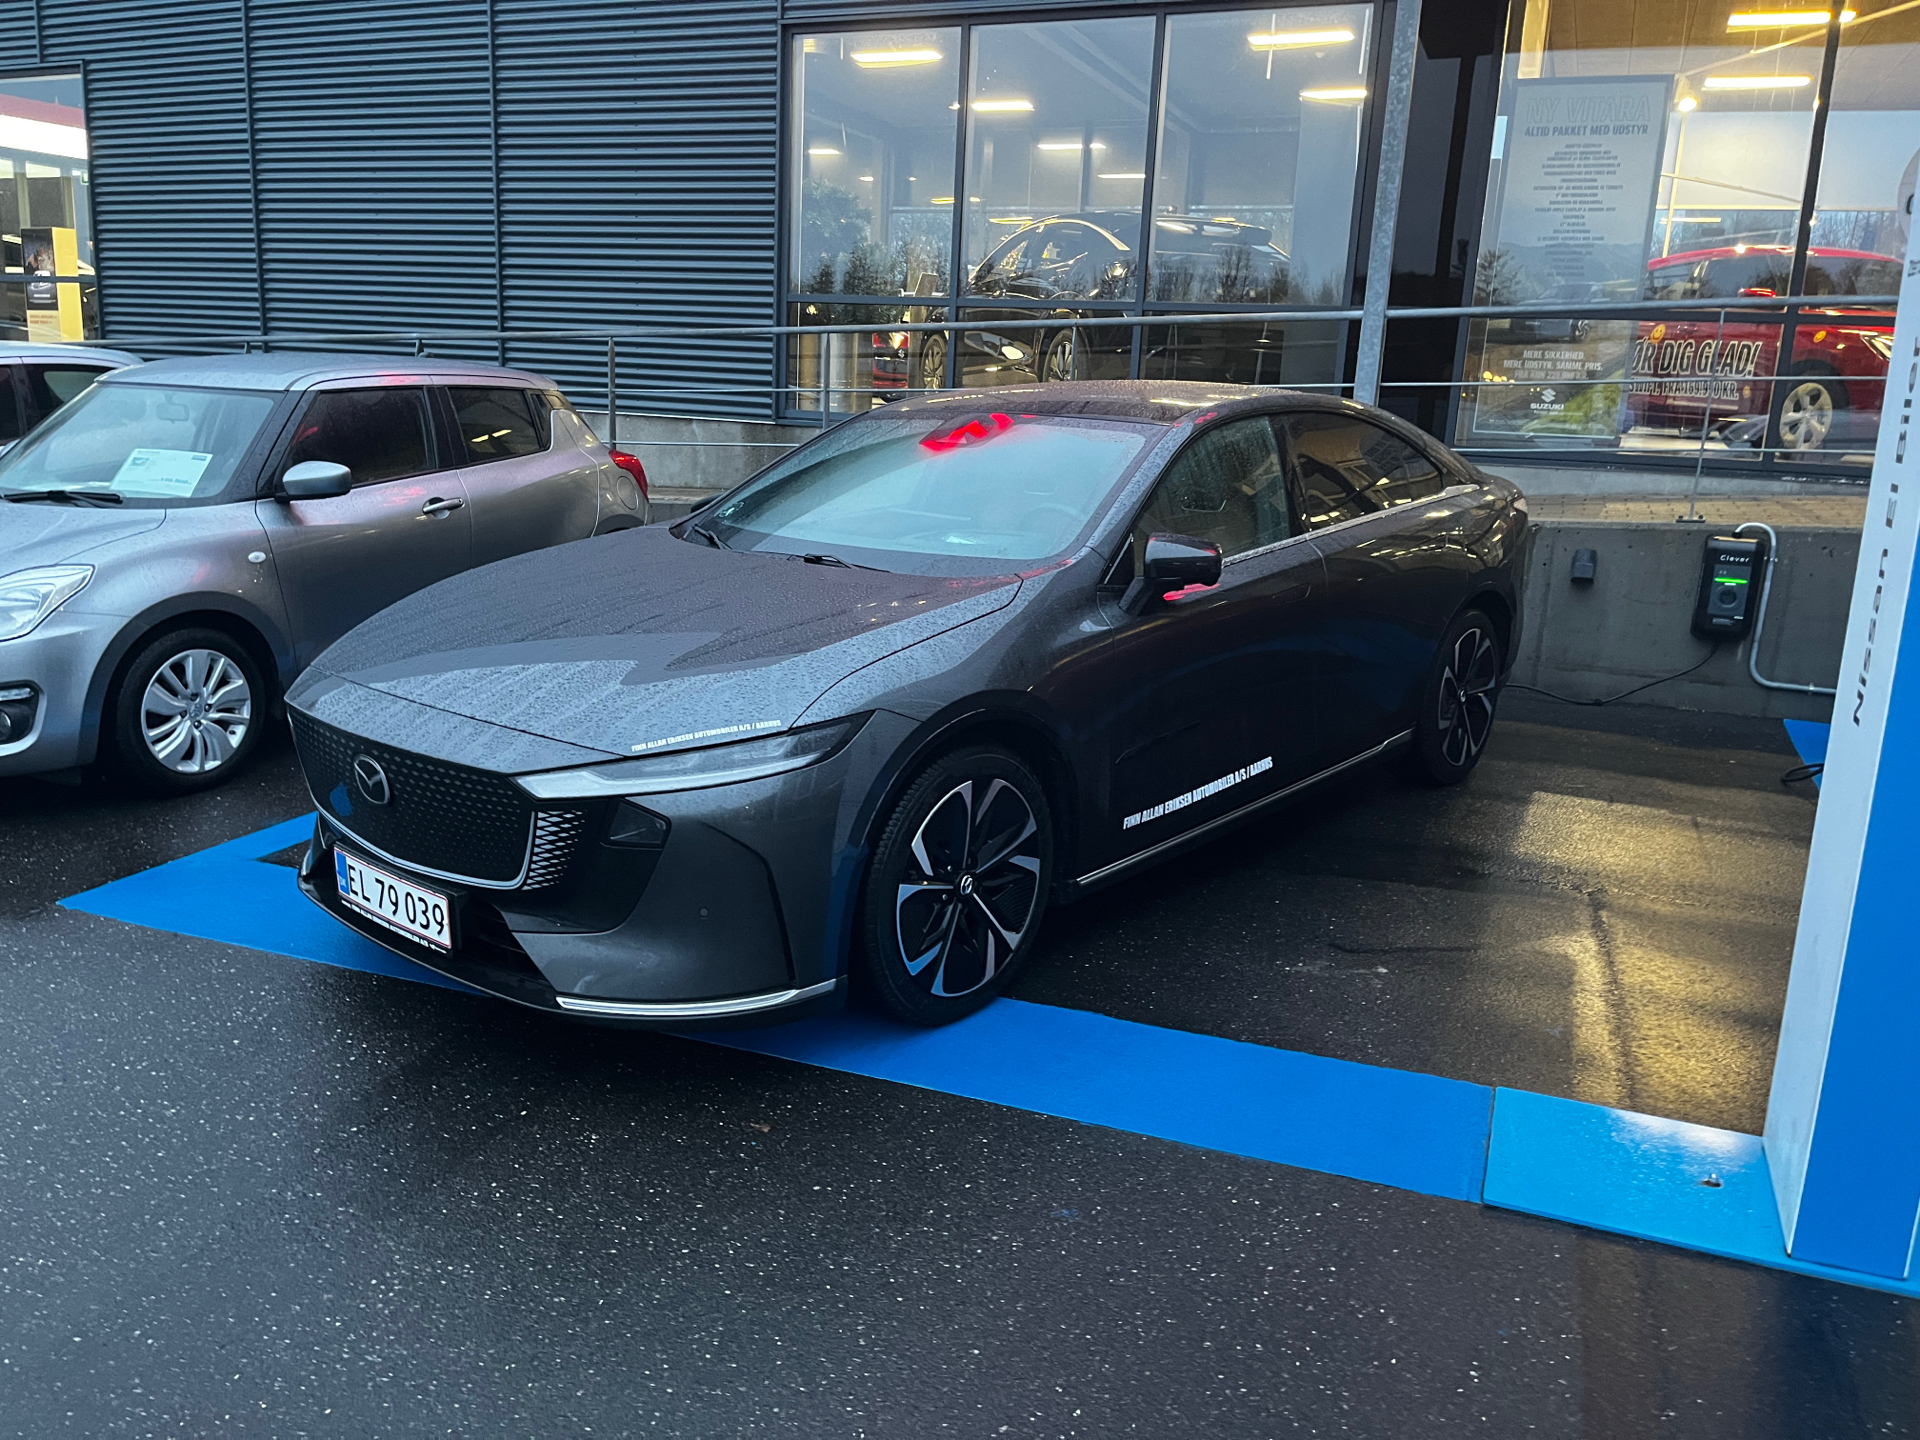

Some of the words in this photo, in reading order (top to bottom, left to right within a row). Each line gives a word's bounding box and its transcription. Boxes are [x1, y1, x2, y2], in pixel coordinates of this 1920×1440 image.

[1526, 98, 1558, 124] NY
[1567, 96, 1650, 123] VITARA
[1525, 126, 1550, 137] ALTID
[1552, 125, 1587, 136] PAKKET
[1589, 125, 1610, 136] MED
[1612, 124, 1649, 135] UDSTYR
[1503, 360, 1523, 368] MERE
[1556, 362, 1583, 370] SAMME
[1584, 362, 1603, 371] PRIS.
[1523, 350, 1542, 359] MERE
[1632, 336, 1658, 374] ØR
[1658, 339, 1695, 375] DIG
[1696, 339, 1763, 378] GLAD!
[1662, 380, 1681, 397] FRA
[1681, 380, 1721, 399] 169.90
[1721, 381, 1740, 400] KR.
[1720, 554, 1750, 562] Clever
[1853, 548, 1889, 727] Nissan
[631, 744, 647, 752] FINN
[647, 738, 666, 749] ALLAN
[668, 732, 694, 744] ERIKSEN
[694, 726, 738, 739] AUTOMOBILER
[739, 723, 751, 732] A/S
[756, 720, 782, 729] AARHUS
[1122, 812, 1142, 830] FINN
[1141, 804, 1164, 823] ALLAN
[1164, 792, 1192, 814] ERIKSEN
[1192, 774, 1236, 802] AUTOMOBILER
[1234, 768, 1246, 784] A/S
[1250, 756, 1274, 777] AARHUS
[348, 864, 371, 903] EL
[375, 877, 399, 916] 79
[405, 892, 444, 936] 039
